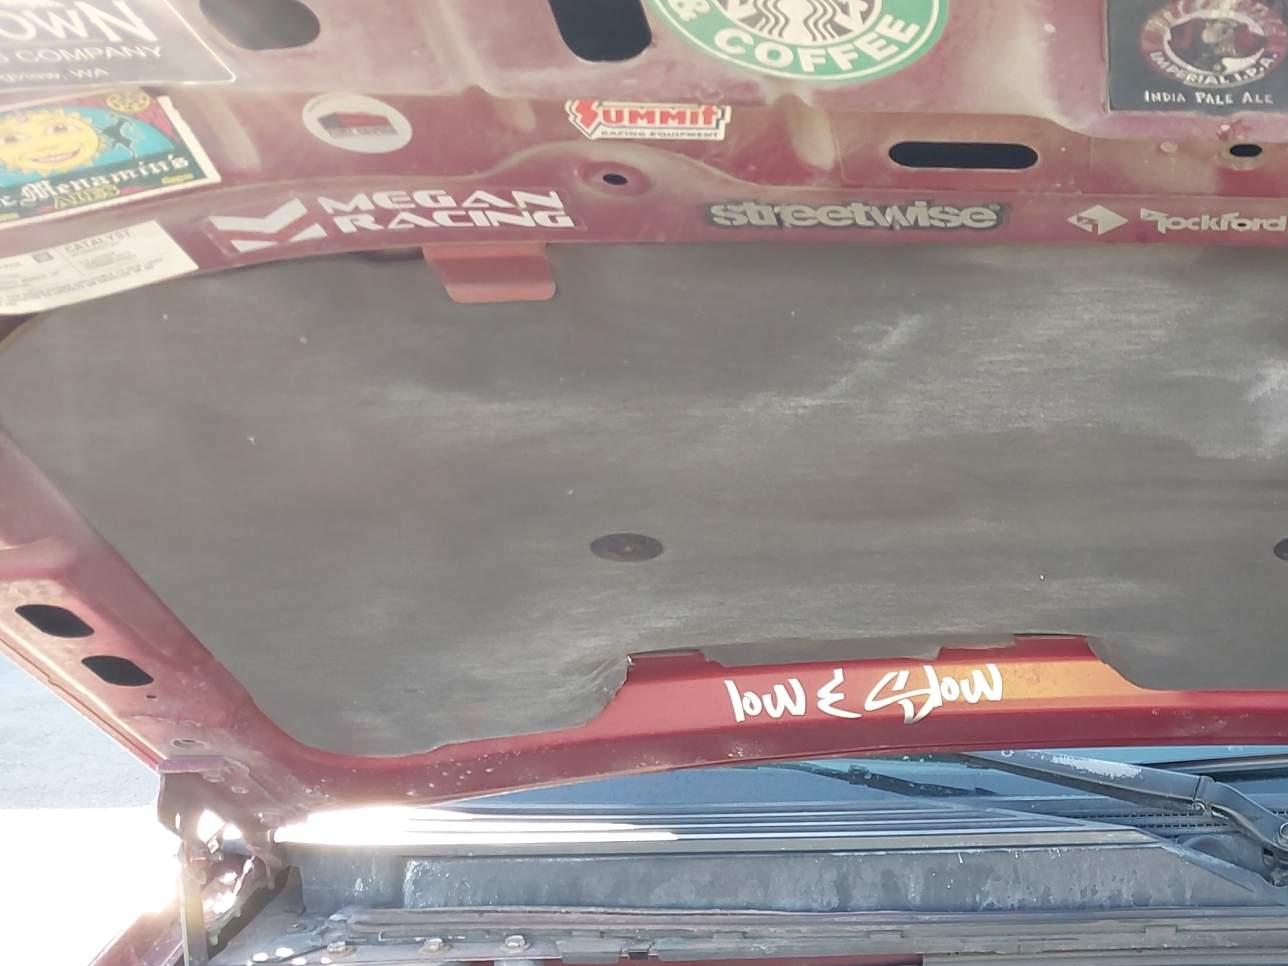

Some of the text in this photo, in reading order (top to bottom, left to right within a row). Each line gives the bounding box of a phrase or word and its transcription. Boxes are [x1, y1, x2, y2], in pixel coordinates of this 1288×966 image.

[15, 45, 161, 63] COMPANY
[713, 14, 920, 73] COFFEE
[1151, 51, 1230, 86] IMPERIAL
[1144, 90, 1274, 105] INDIA PALE ALE
[317, 190, 565, 214] MEGAN
[333, 210, 575, 234] RACING
[710, 201, 999, 231] streetwise
[1140, 207, 1287, 234] Rockford
